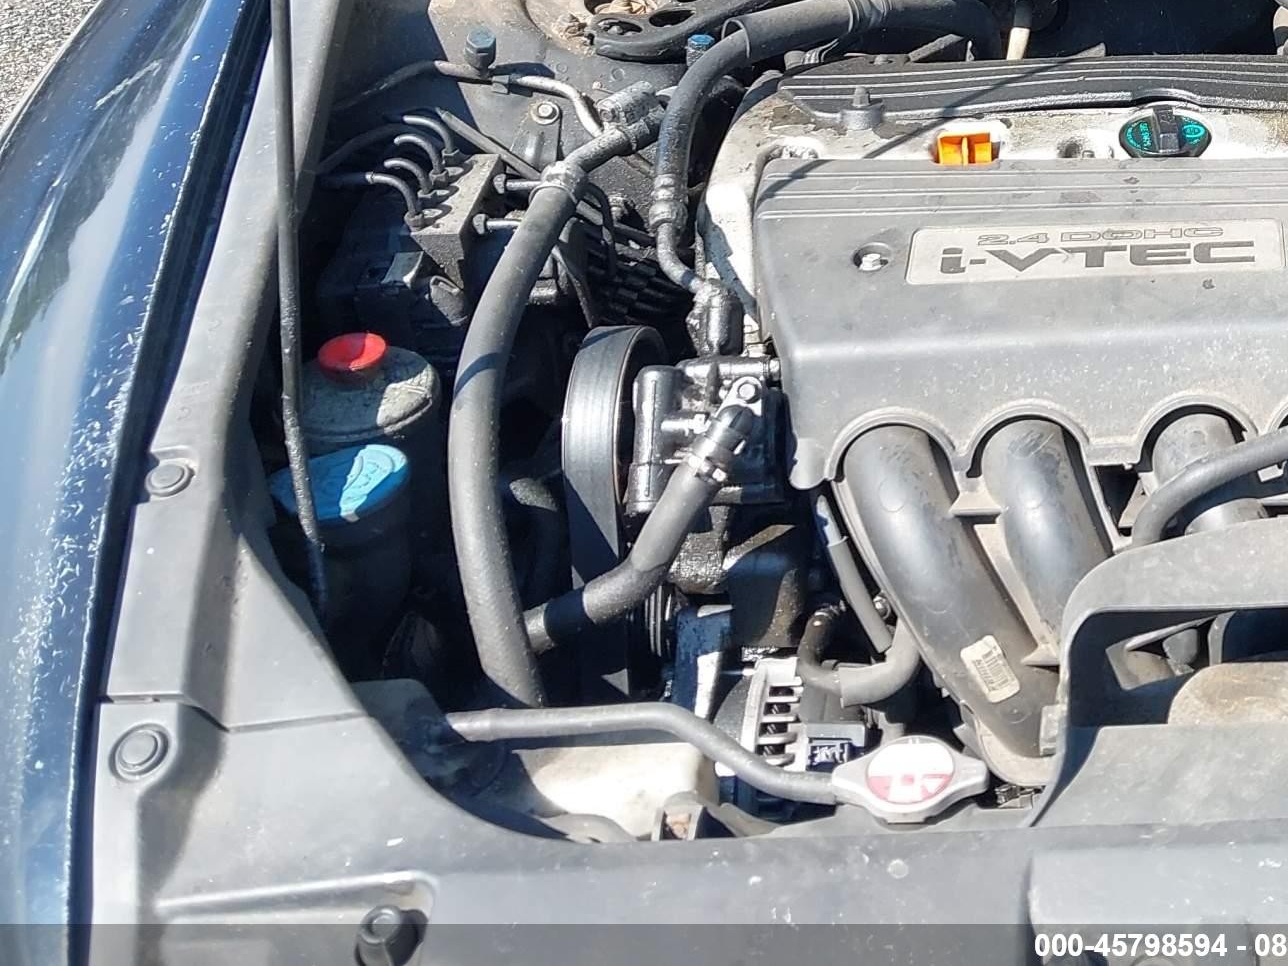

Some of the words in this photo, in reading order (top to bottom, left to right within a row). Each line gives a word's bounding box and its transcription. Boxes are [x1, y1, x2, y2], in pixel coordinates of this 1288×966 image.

[978, 232, 1049, 246] 2.4
[1060, 227, 1223, 242] DOHC
[940, 240, 1256, 274] i-VTEC
